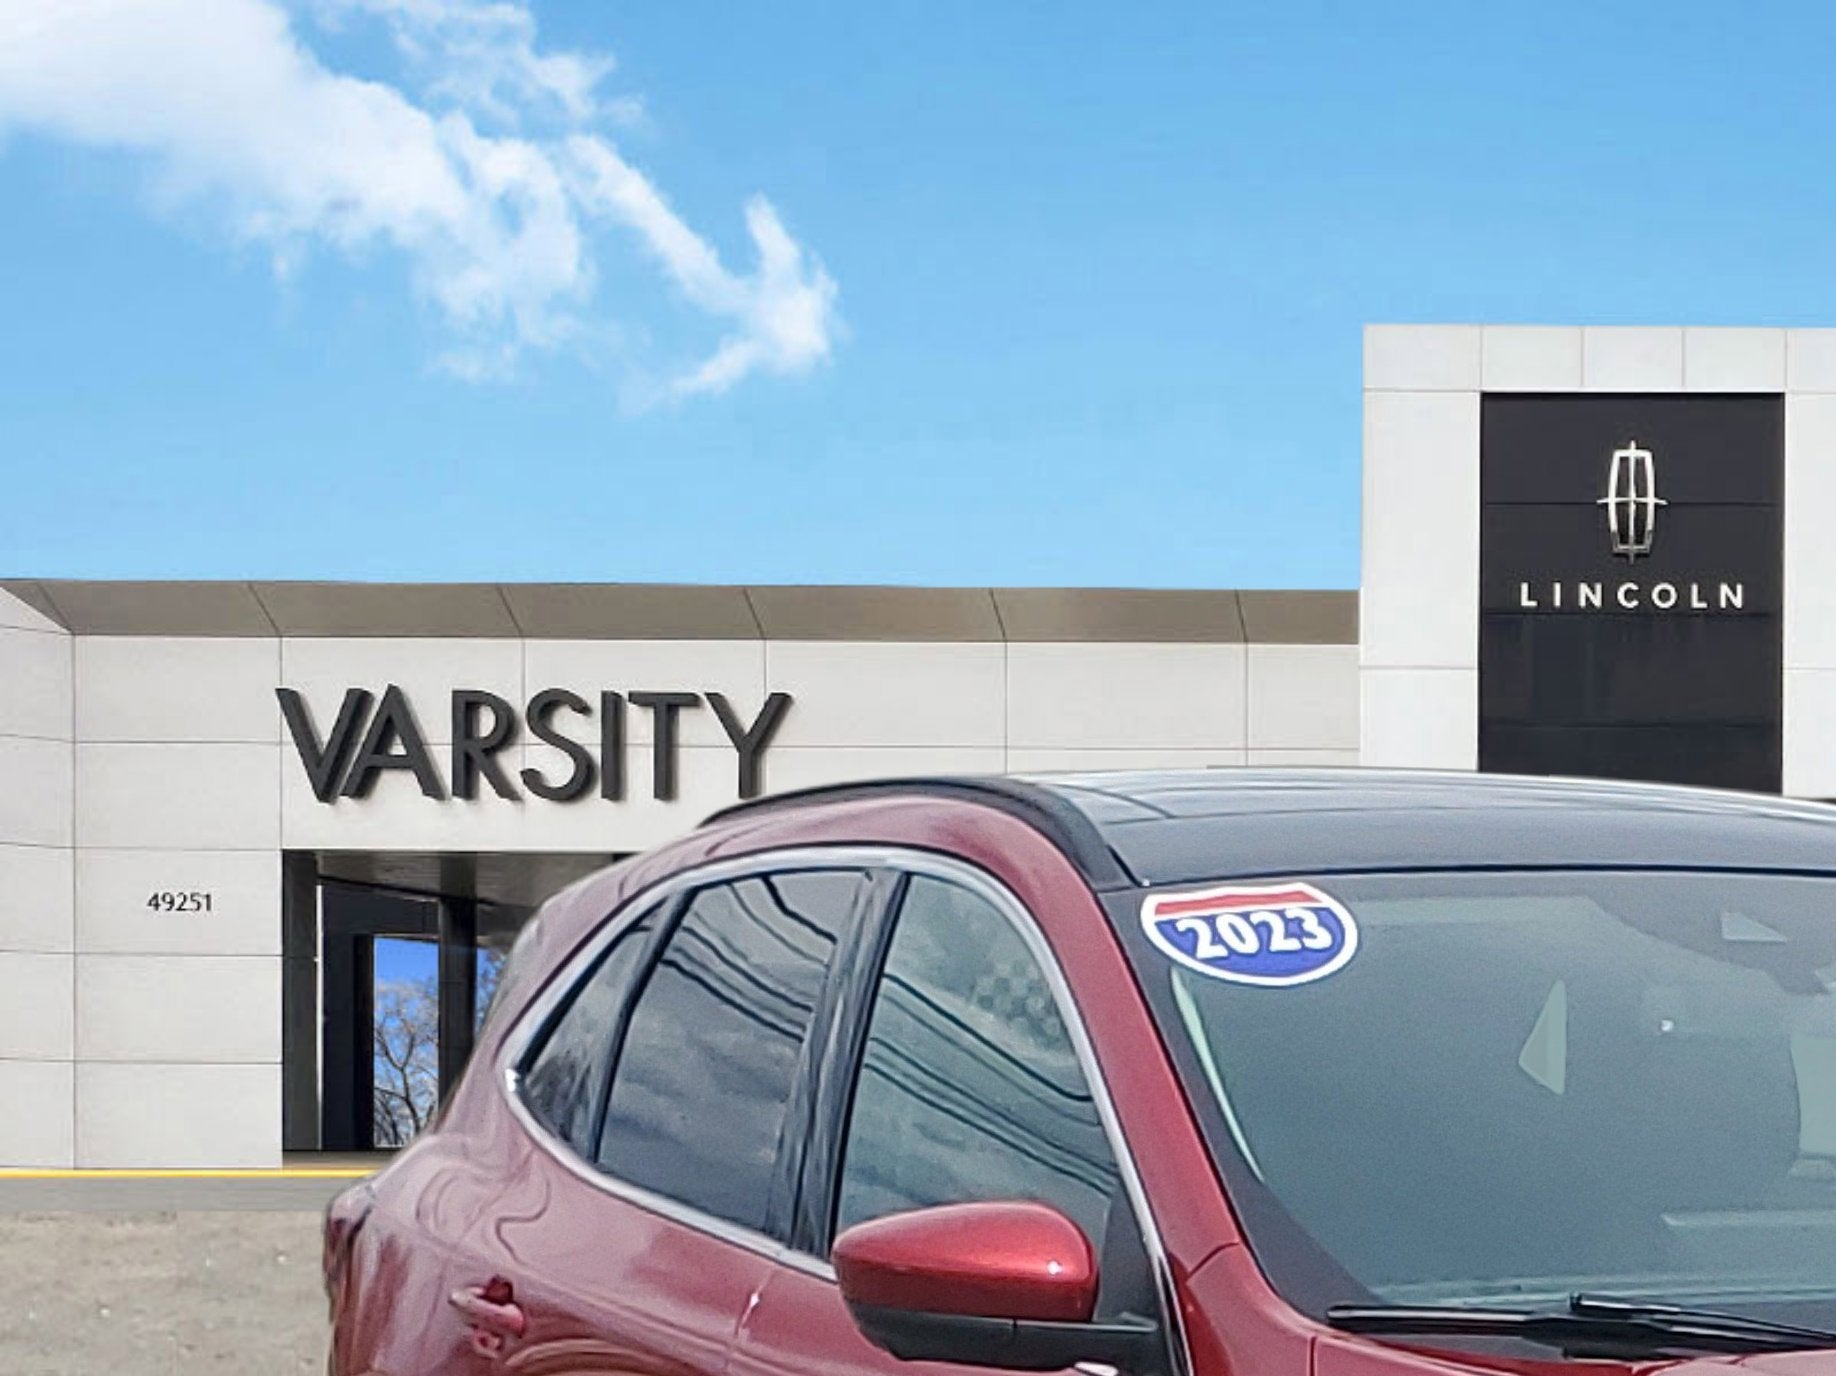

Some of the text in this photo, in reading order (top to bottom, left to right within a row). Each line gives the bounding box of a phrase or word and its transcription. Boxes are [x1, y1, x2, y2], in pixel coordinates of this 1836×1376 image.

[1520, 582, 1744, 609] LINCOLN
[275, 683, 794, 805] VARSITY
[147, 892, 212, 912] 49251
[1175, 907, 1333, 960] 2023
